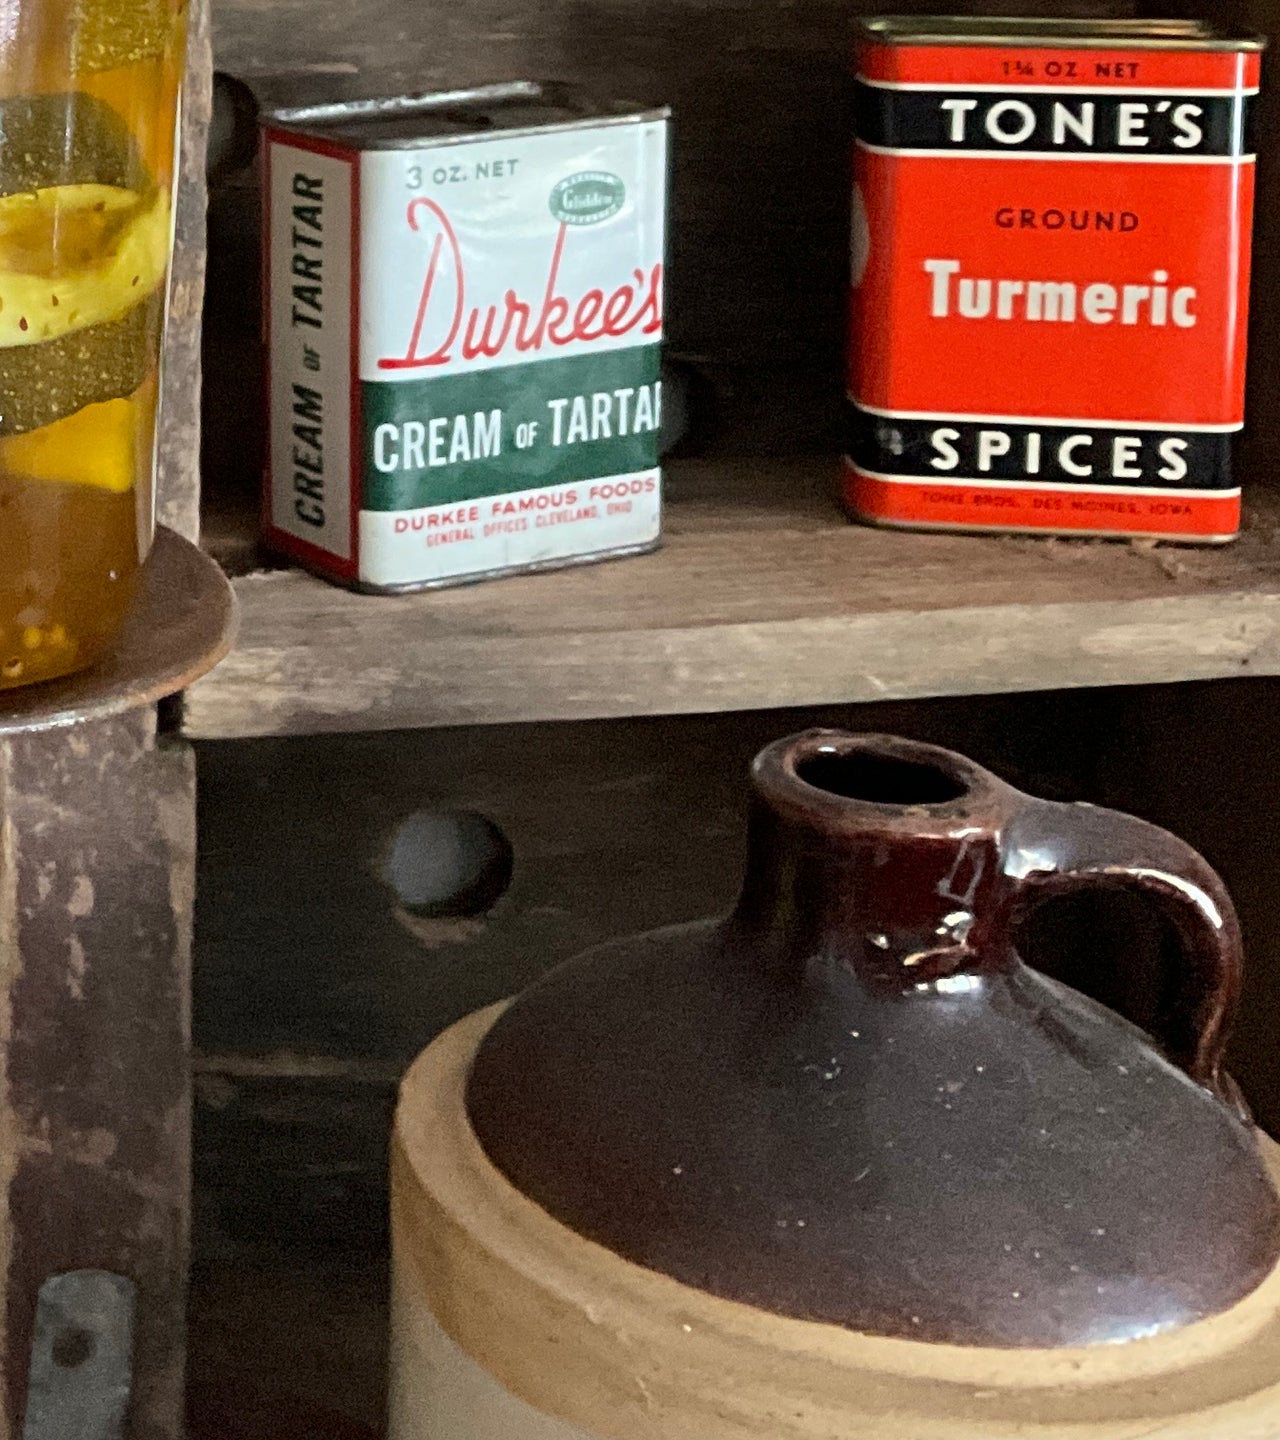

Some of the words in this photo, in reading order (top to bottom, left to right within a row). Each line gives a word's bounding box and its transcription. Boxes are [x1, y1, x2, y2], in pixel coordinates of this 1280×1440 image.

[1045, 61, 1077, 77] OZ
[1095, 62, 1139, 78] NET
[940, 98, 1204, 149] TONE'S
[405, 166, 423, 190] 3
[432, 167, 468, 185] OZ.
[475, 159, 520, 180] NET
[994, 207, 1140, 232] GROUND
[292, 172, 325, 329] TARTAR
[377, 195, 663, 371] Durkee's
[923, 258, 1197, 328] Turmeric
[302, 348, 322, 372] OF
[292, 383, 326, 528] CREAM
[373, 408, 502, 473] CREAM
[515, 421, 539, 449] OF
[928, 428, 1189, 481] SPICES
[393, 506, 479, 534] DURKEE
[491, 489, 578, 517] FAMOUS
[588, 476, 656, 501] FOODS
[426, 528, 476, 548] GENERAL
